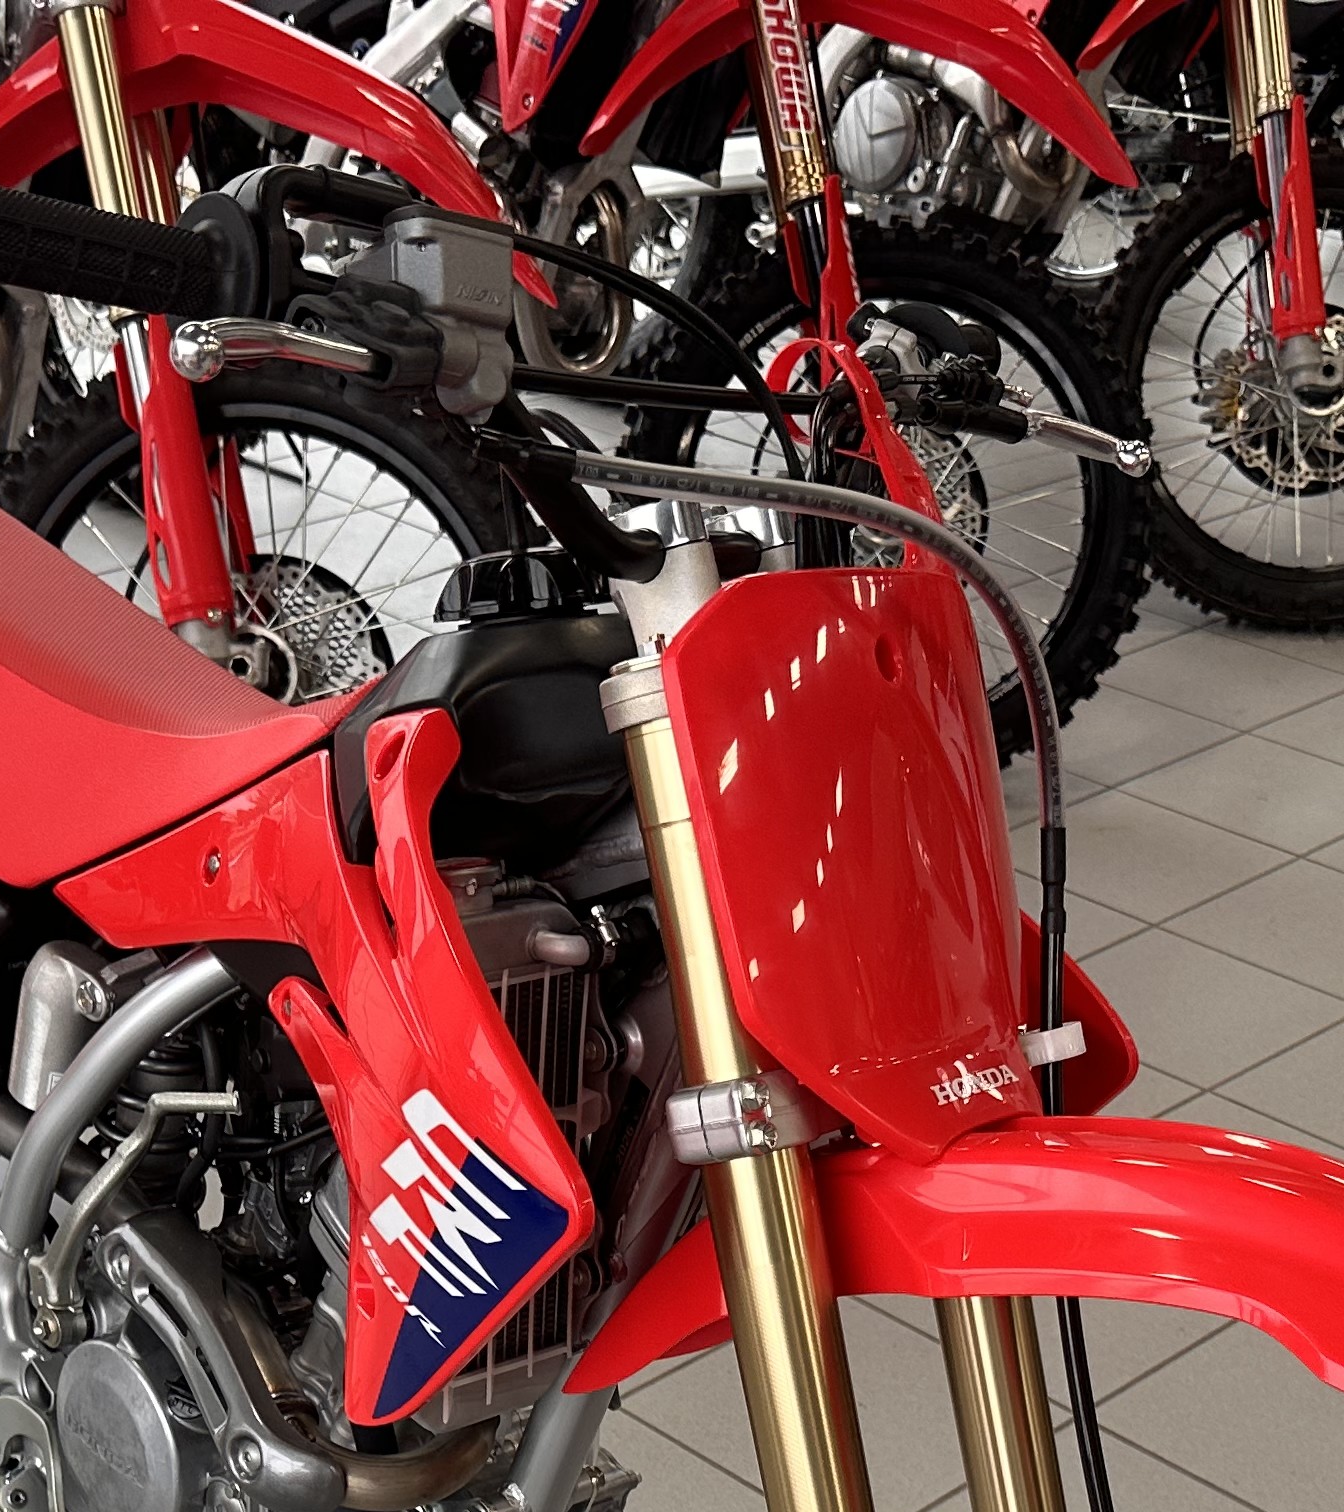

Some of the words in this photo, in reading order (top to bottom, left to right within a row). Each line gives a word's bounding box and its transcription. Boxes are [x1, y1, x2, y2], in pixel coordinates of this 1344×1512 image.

[760, 0, 813, 131] HOWA
[929, 1064, 1020, 1106] HONDA
[368, 1088, 528, 1298] CRF
[360, 1231, 447, 1350] 150R
